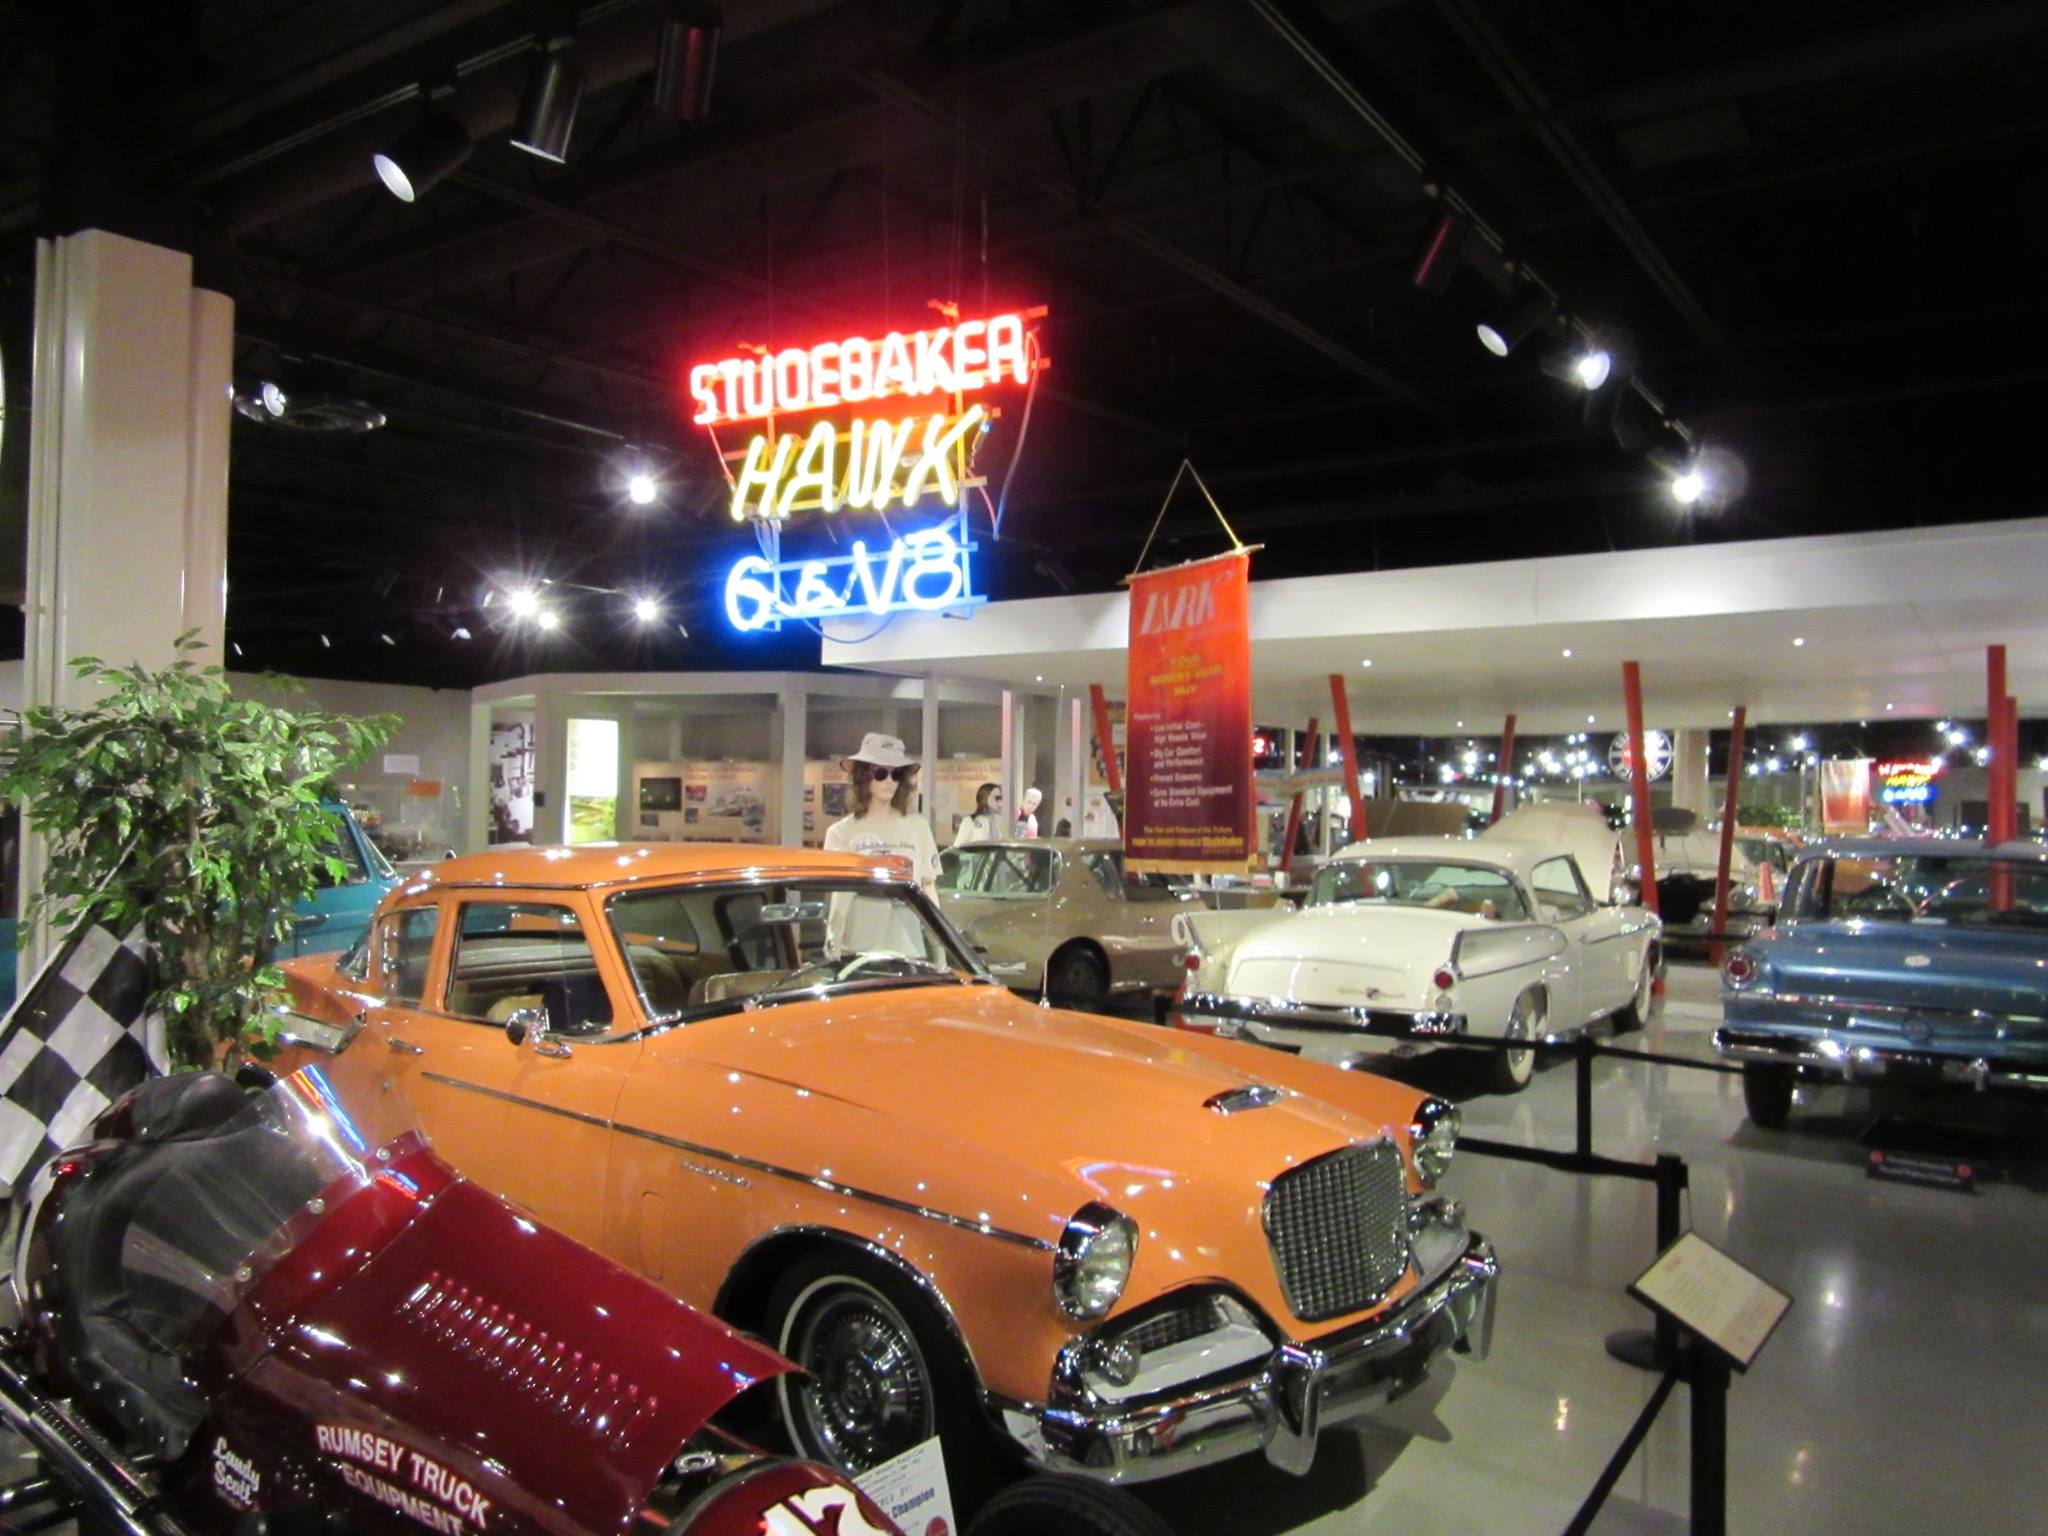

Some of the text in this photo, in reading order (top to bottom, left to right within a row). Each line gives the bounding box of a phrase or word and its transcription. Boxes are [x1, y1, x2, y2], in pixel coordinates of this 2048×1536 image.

[689, 313, 1029, 425] STUDEBAKER
[730, 403, 985, 522] HAWK
[215, 1461, 253, 1505] Scott
[316, 1425, 490, 1529] RUMSEY TRUCK
[341, 1462, 464, 1536] EQUIPMENT
[891, 1487, 935, 1519] Champion
